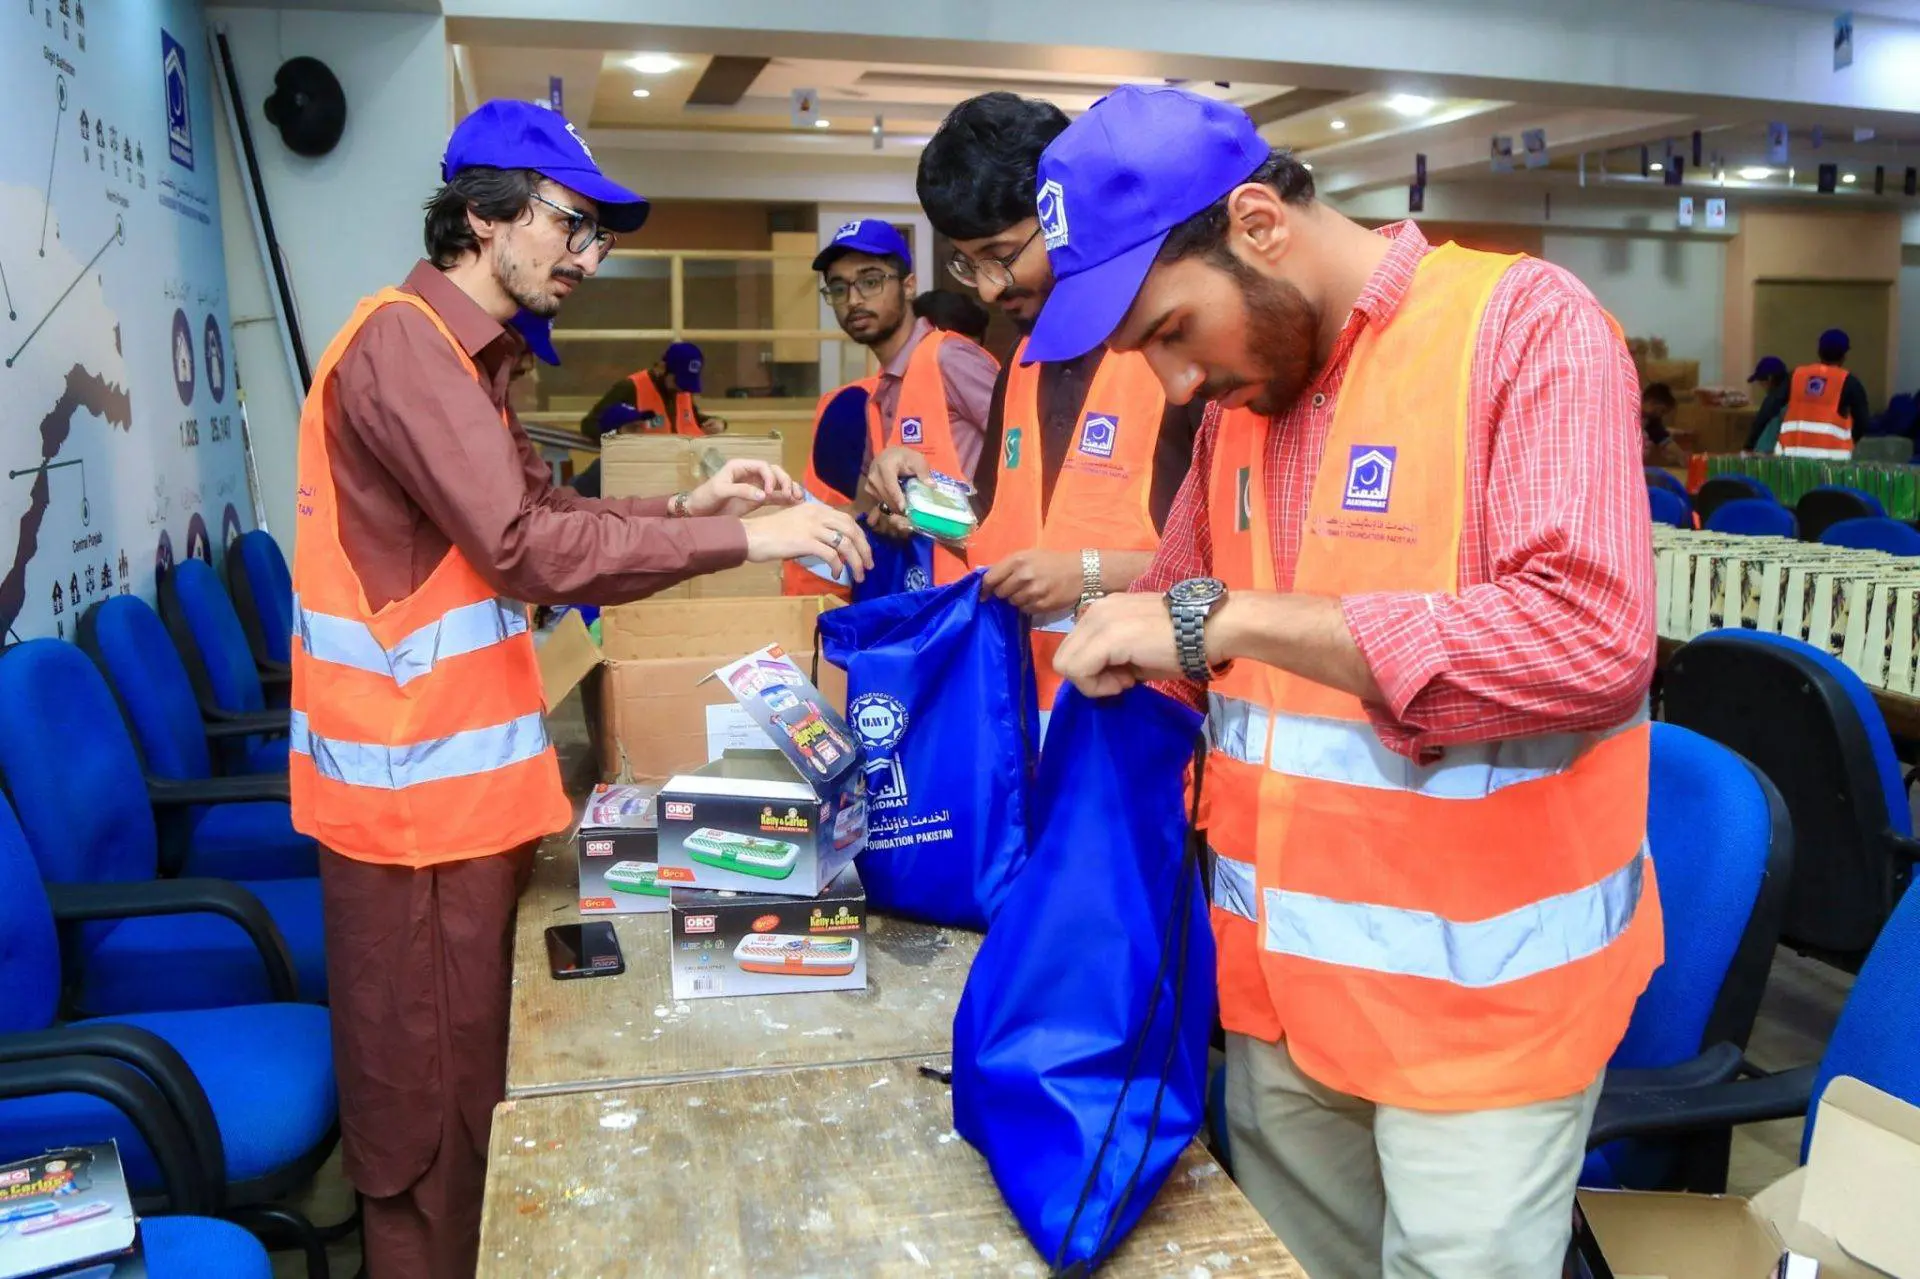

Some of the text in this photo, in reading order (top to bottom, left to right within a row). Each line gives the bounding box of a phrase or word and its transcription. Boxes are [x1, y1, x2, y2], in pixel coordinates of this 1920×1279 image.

[667, 804, 691, 814] ORO
[916, 829, 953, 844] PAKISTAN
[588, 842, 611, 851] ORO
[686, 918, 713, 928] ORO
